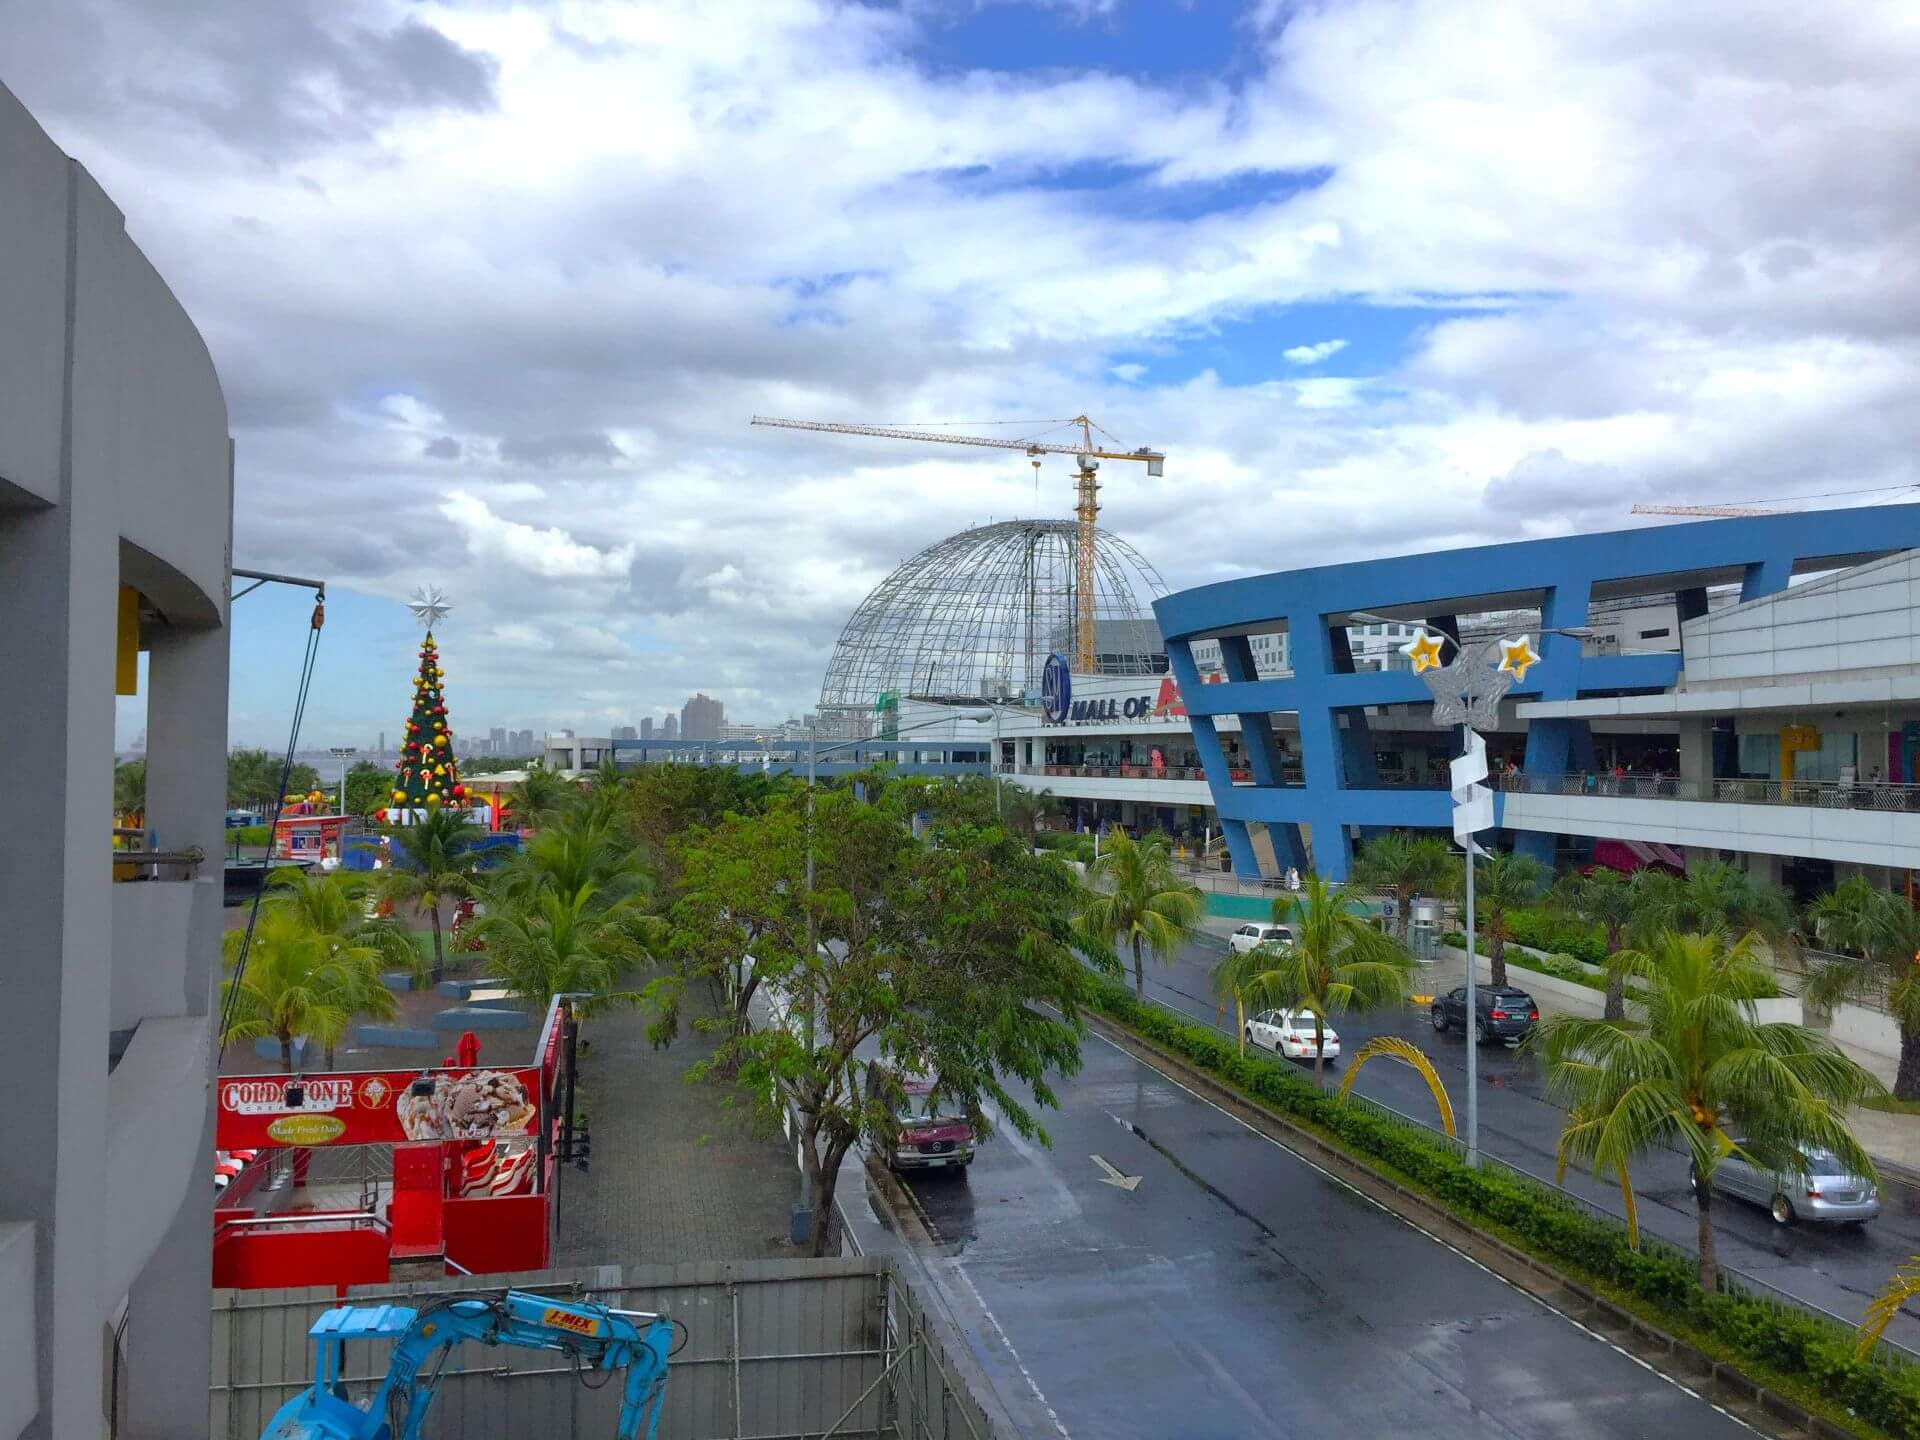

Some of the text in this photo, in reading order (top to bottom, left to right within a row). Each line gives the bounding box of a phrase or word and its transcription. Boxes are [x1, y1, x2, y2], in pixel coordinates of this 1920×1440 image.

[1070, 698, 1119, 721] MALL
[1123, 696, 1151, 719] OF
[222, 1083, 280, 1111] COLD
